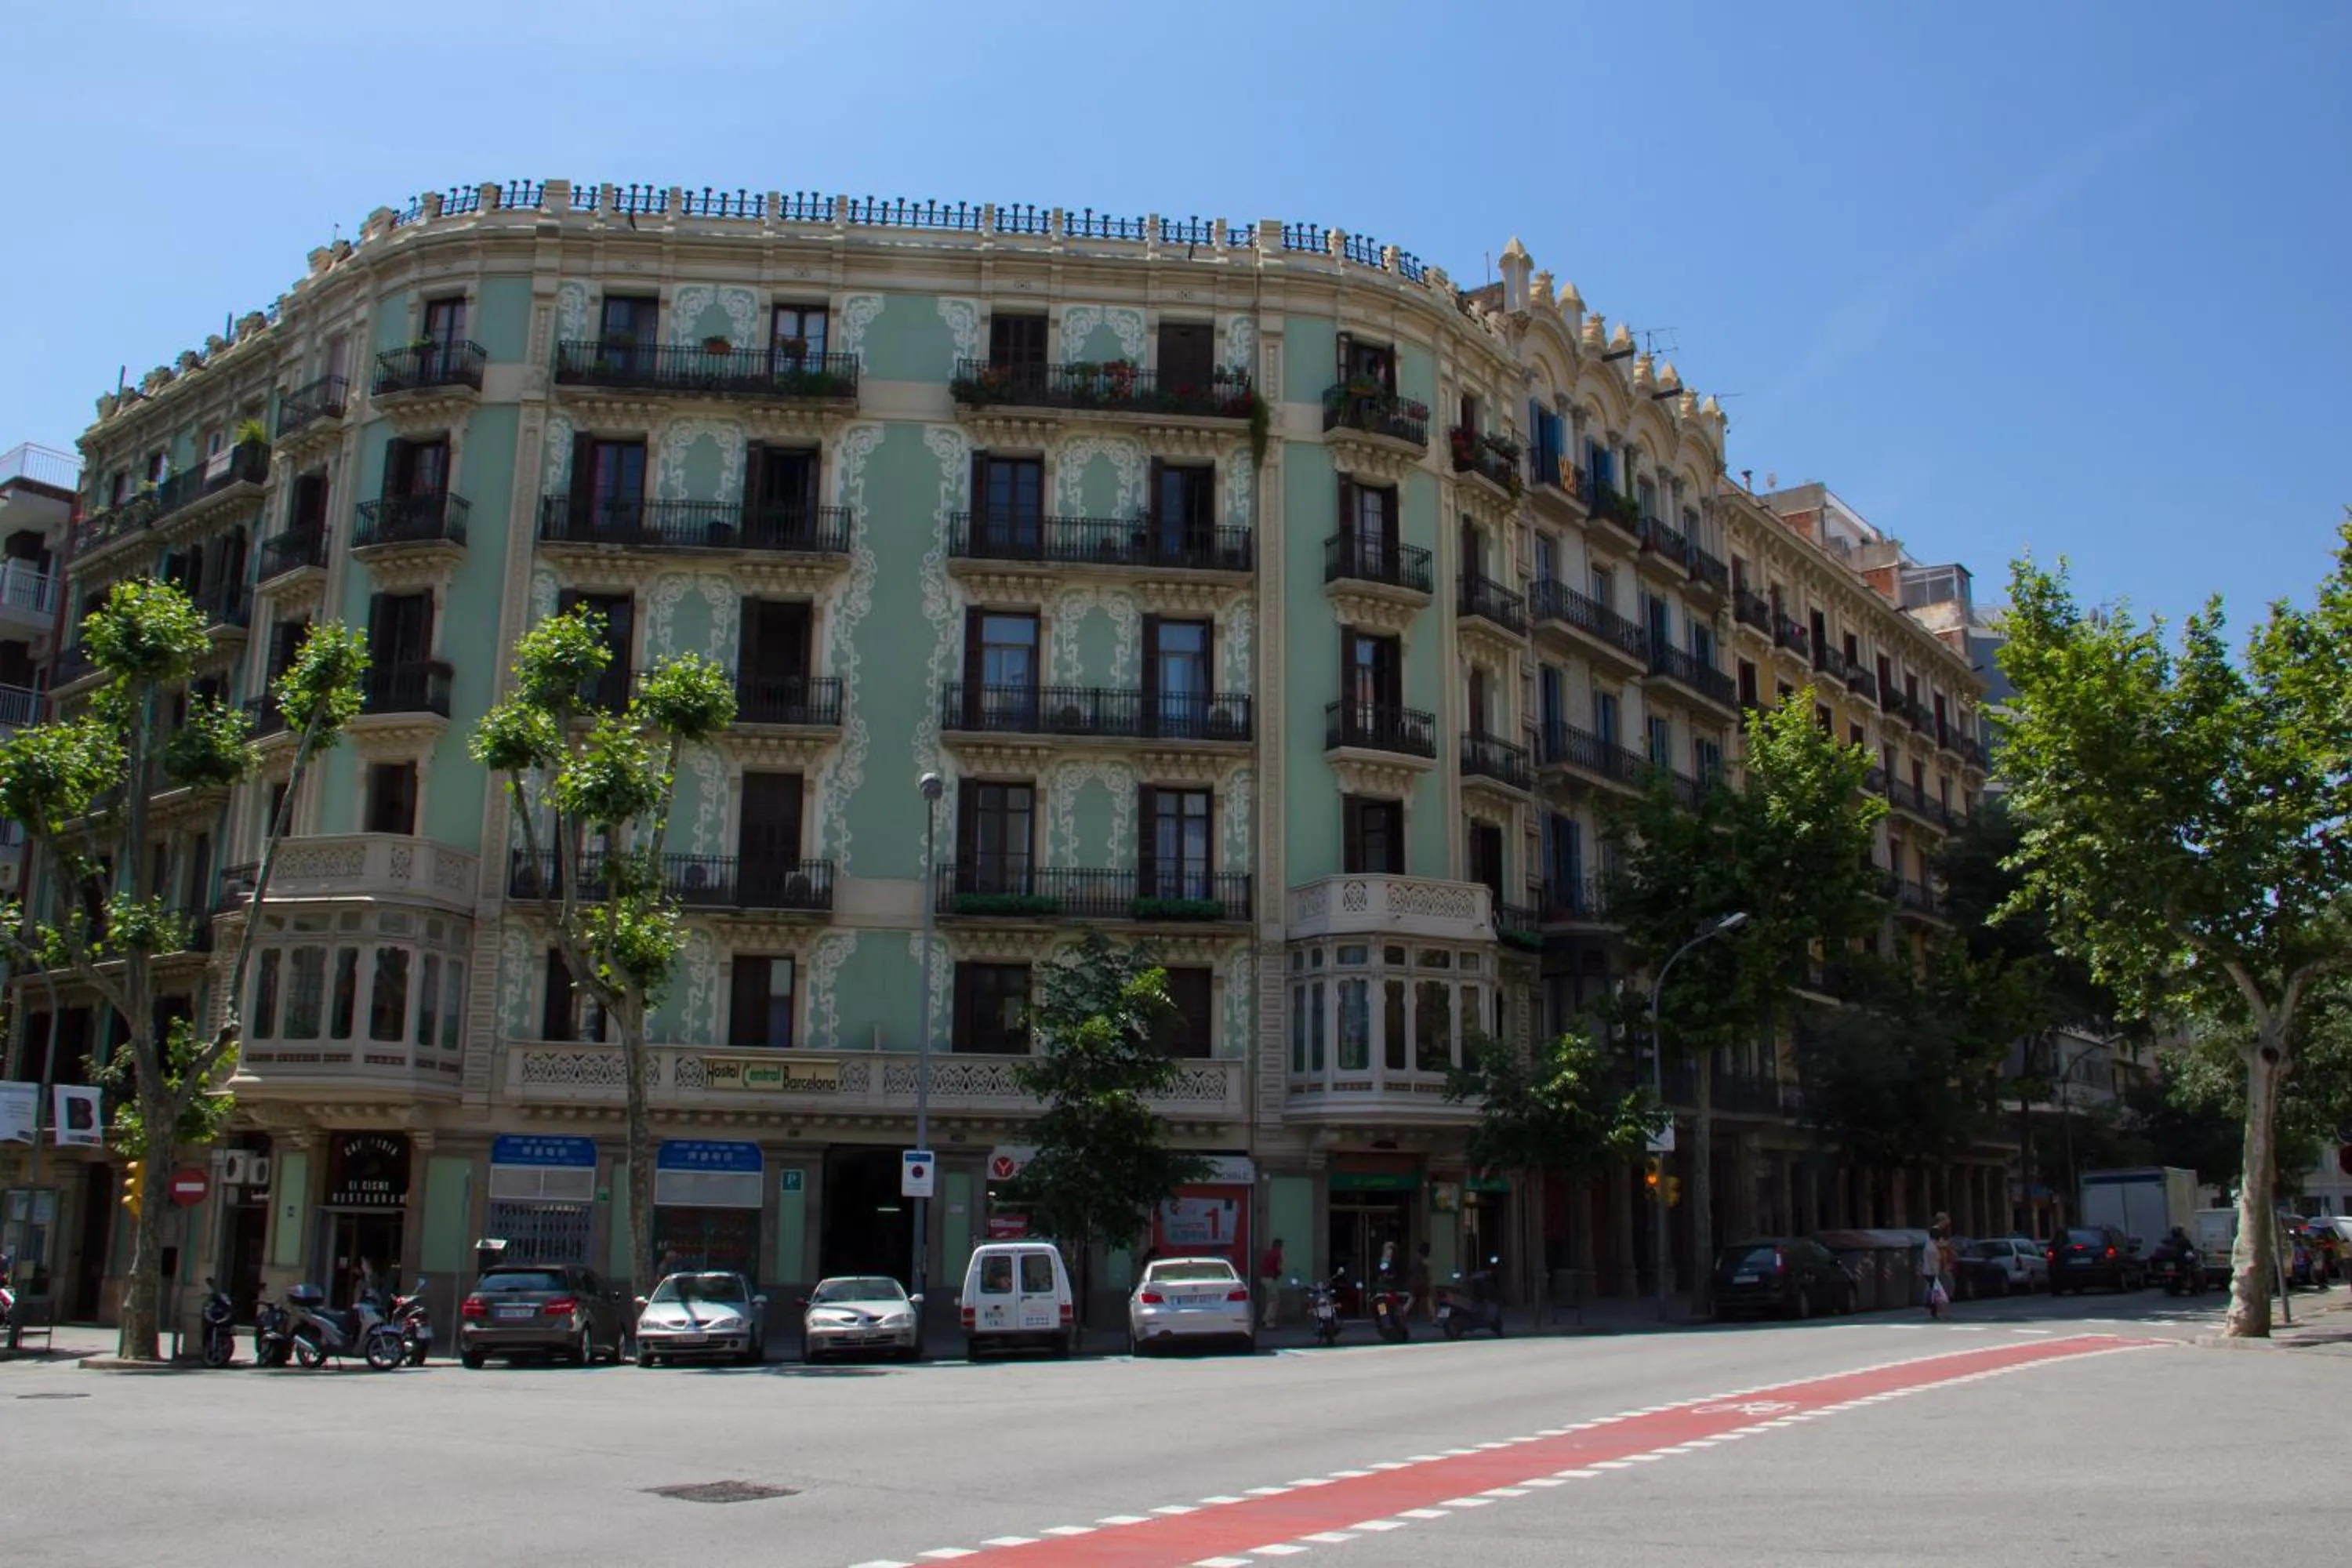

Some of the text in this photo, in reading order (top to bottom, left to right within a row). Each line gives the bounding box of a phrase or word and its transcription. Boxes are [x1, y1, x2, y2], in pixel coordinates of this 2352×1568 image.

[706, 1062, 740, 1087] Hostal
[783, 1065, 837, 1090] Barcelona
[67, 1097, 93, 1130] B
[787, 1172, 797, 1185] P
